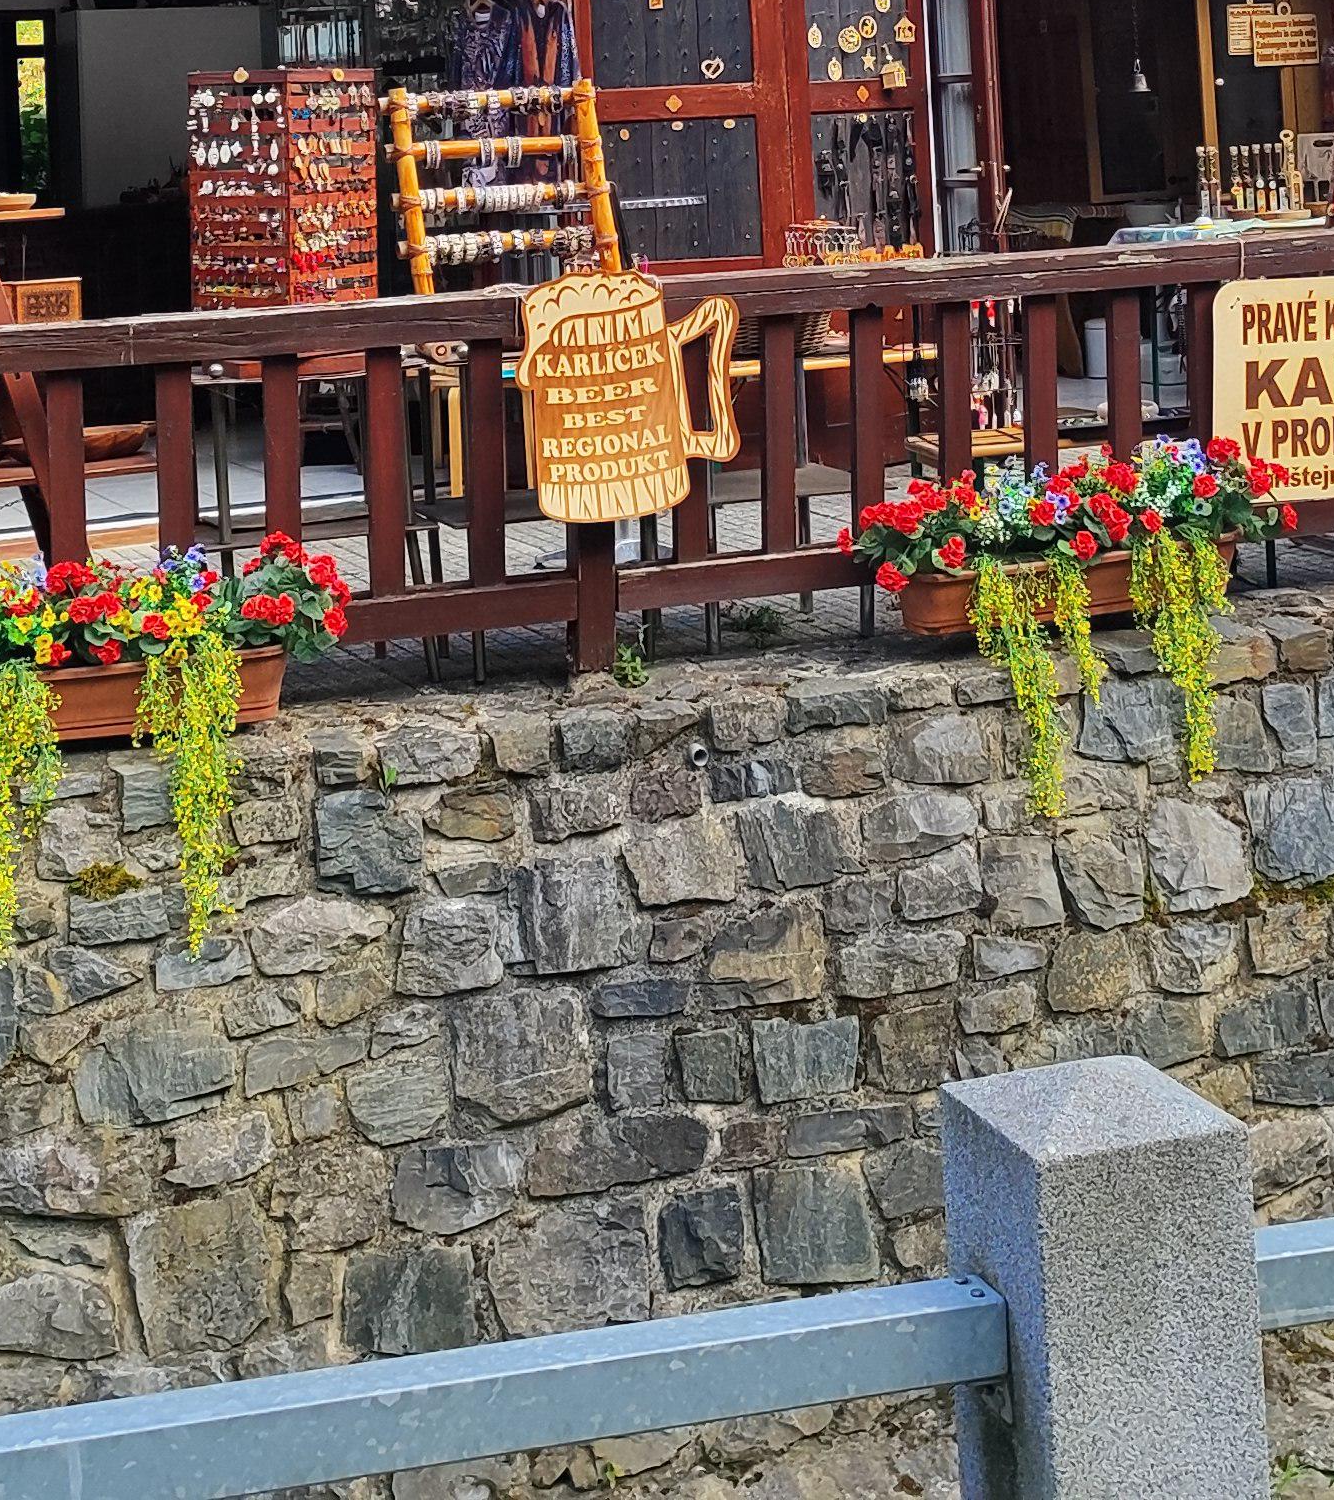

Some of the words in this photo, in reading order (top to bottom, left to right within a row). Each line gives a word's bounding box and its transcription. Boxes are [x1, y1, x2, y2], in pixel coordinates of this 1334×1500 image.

[1242, 291, 1318, 345] PRAVÉ
[535, 340, 665, 378] KARLÍČEK
[545, 378, 659, 404] BEER
[562, 405, 648, 429] BEST
[541, 424, 672, 458] REGIONAL
[1242, 421, 1262, 459] V
[547, 449, 670, 483] PRODUKT
